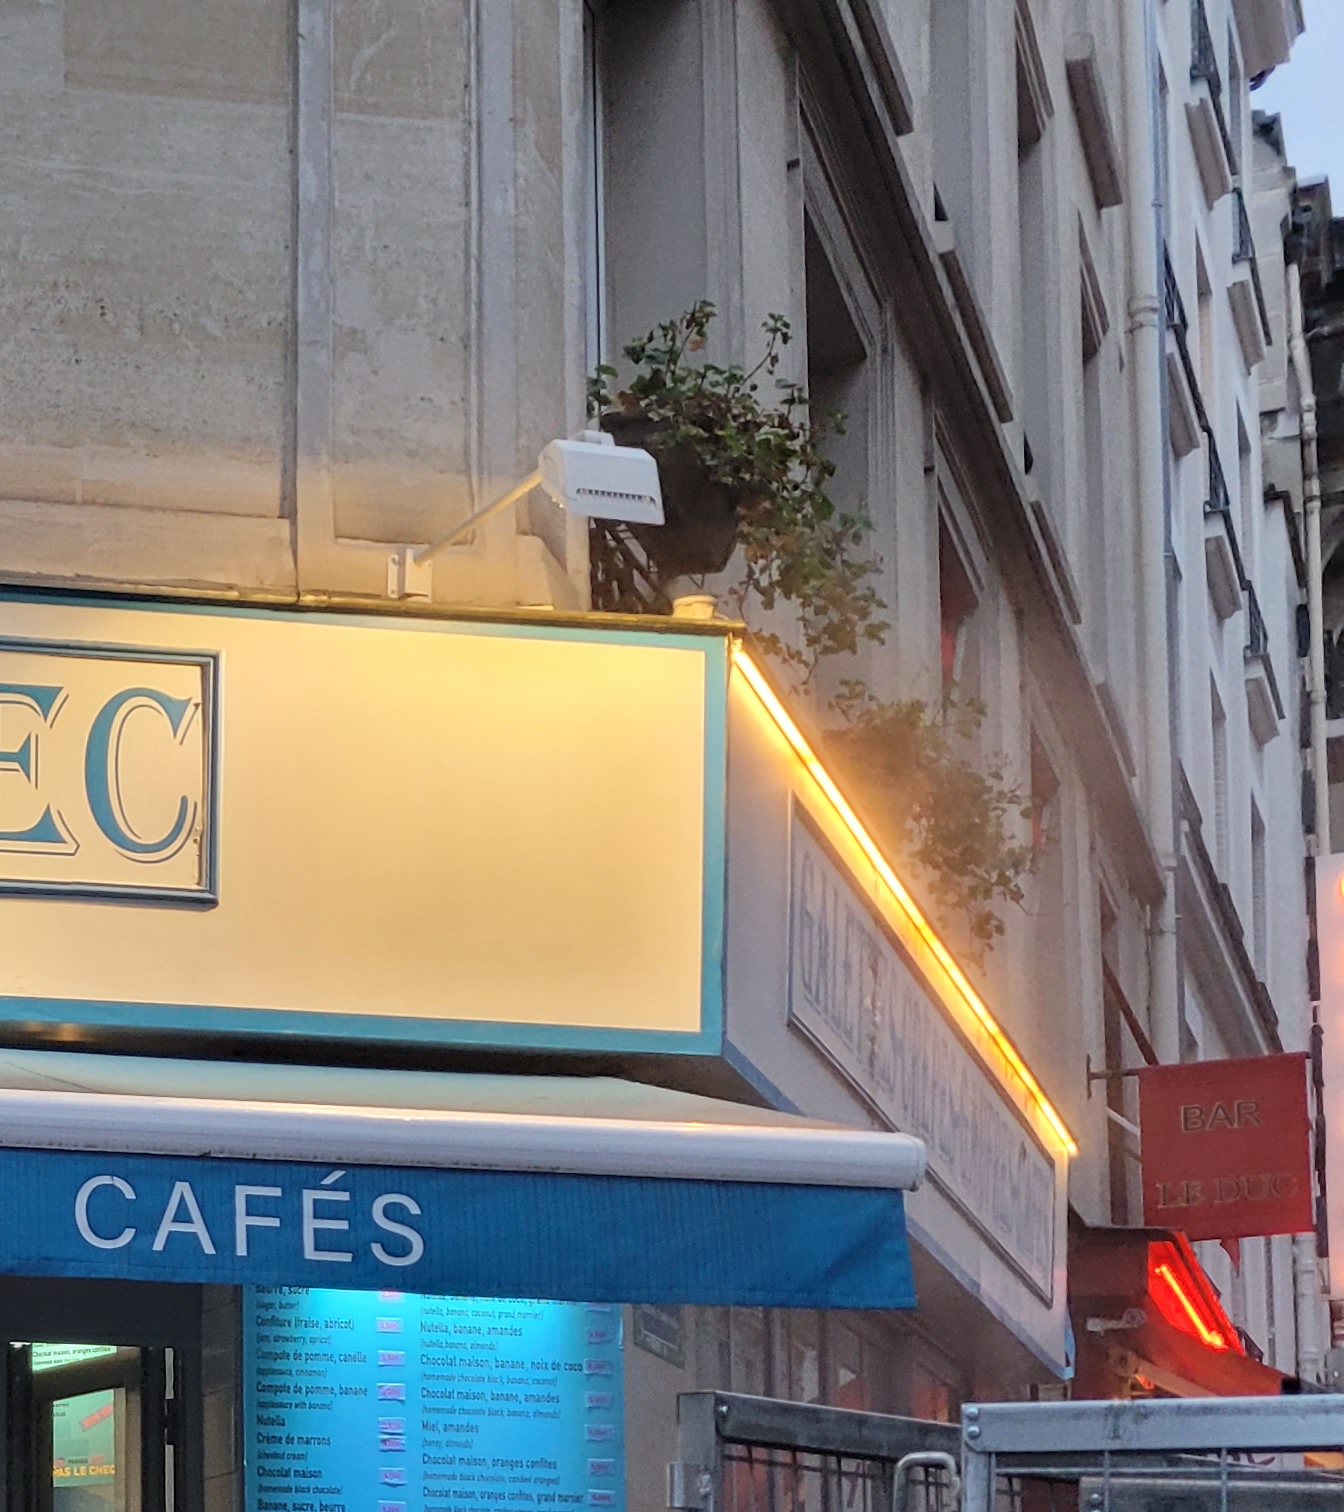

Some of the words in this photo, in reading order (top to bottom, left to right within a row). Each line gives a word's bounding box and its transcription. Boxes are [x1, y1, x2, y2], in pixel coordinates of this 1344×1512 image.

[1181, 1100, 1261, 1133] BAR
[1156, 1180, 1202, 1209] LE
[73, 1169, 426, 1268] CAFÉS
